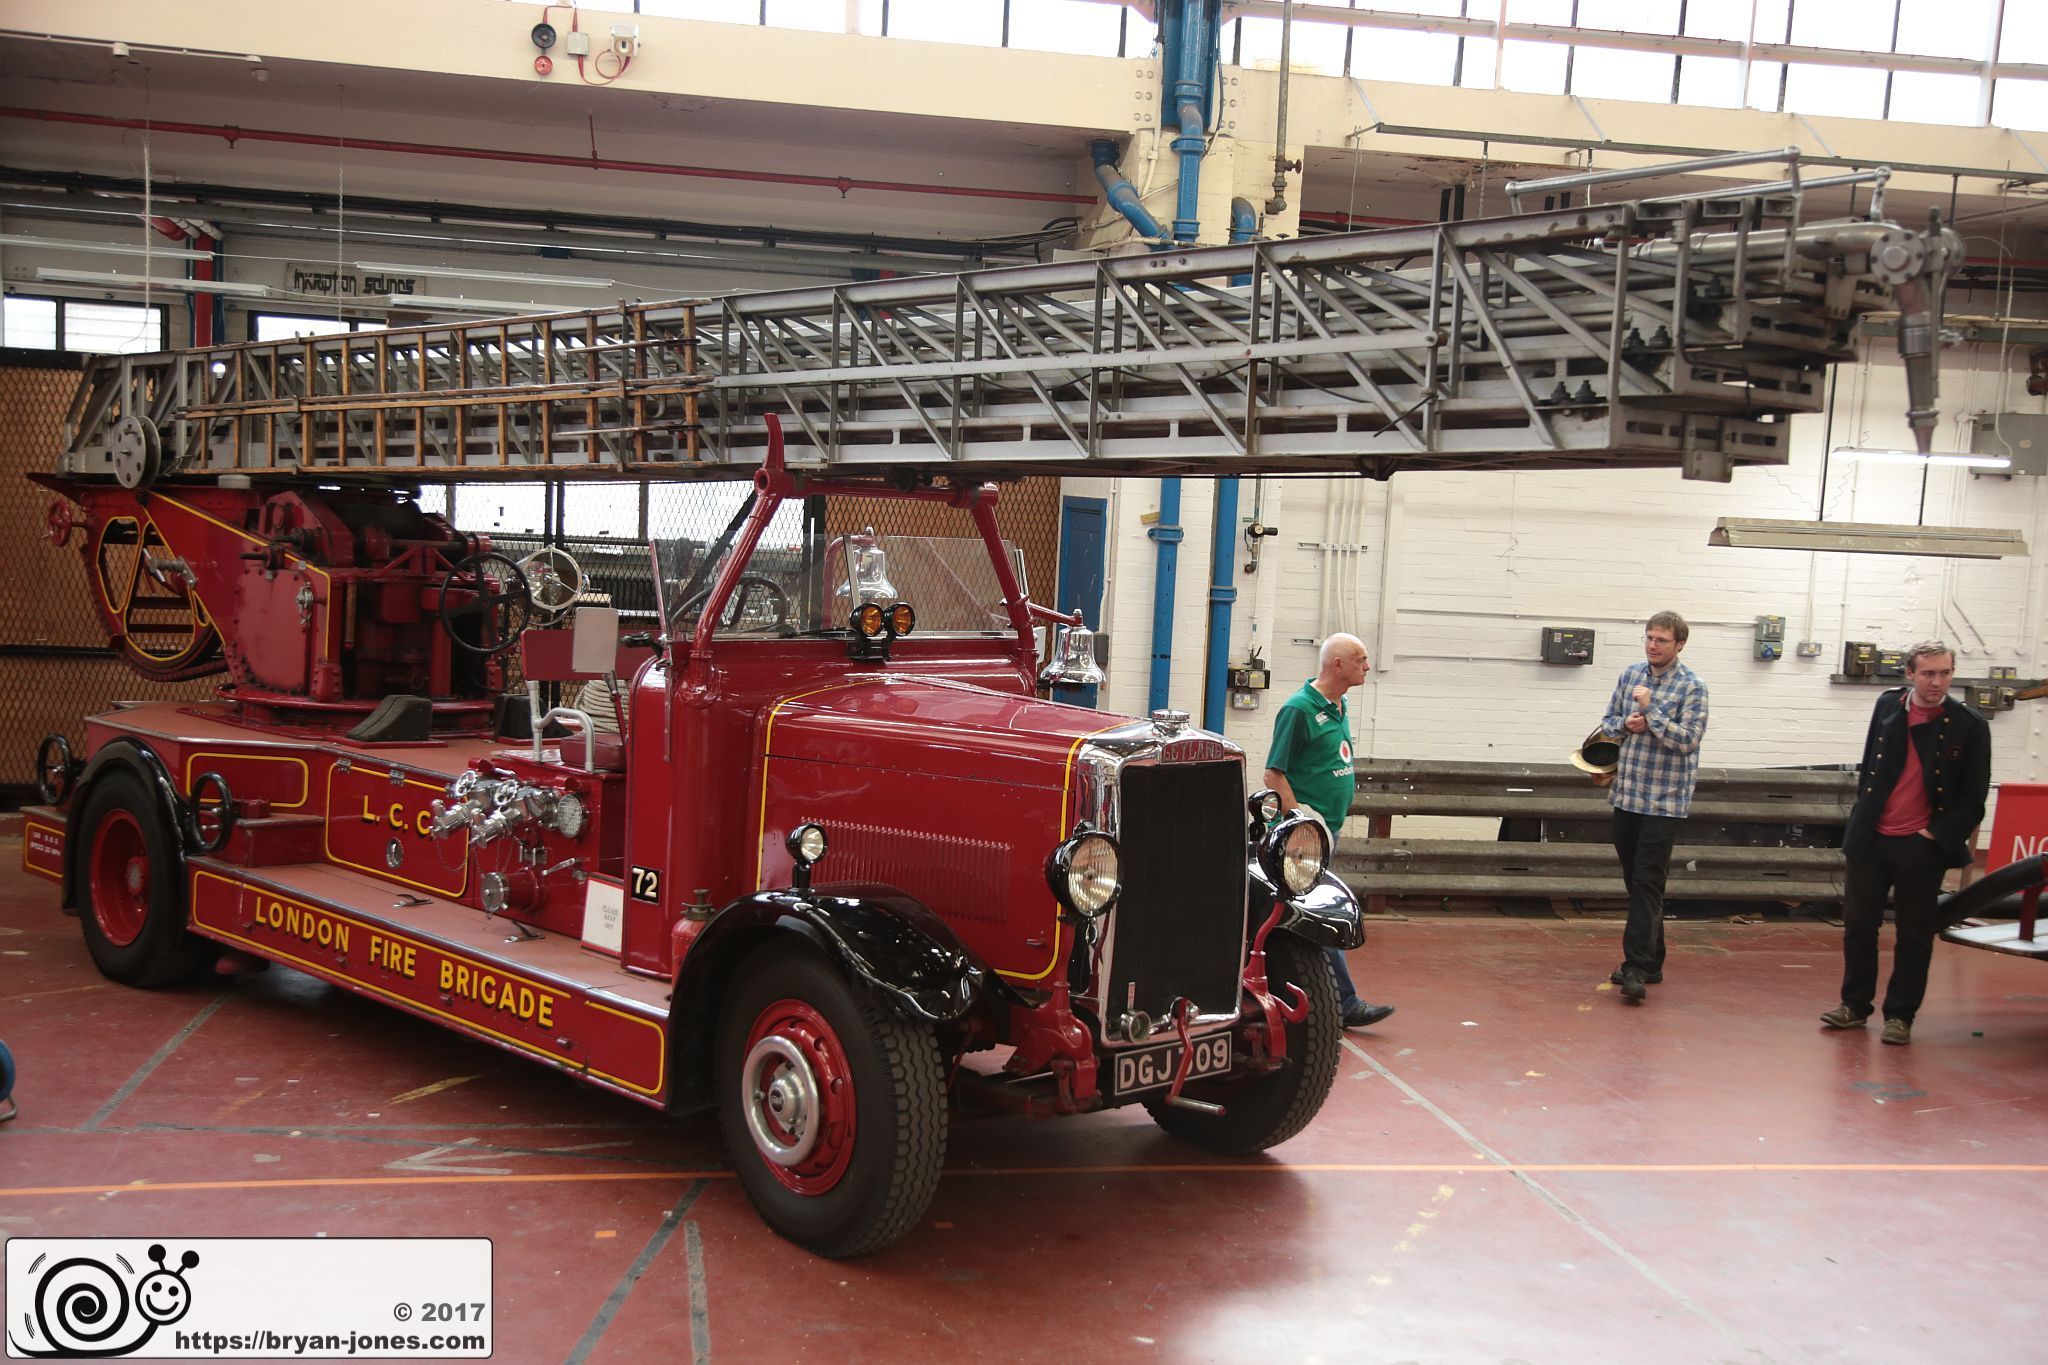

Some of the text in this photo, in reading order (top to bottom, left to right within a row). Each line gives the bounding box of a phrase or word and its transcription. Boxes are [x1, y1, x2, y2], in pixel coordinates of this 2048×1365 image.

[632, 867, 657, 898] 72
[255, 896, 554, 1027] LONDON FIRE BRIGADE
[1119, 1049, 1172, 1089] DGJ
